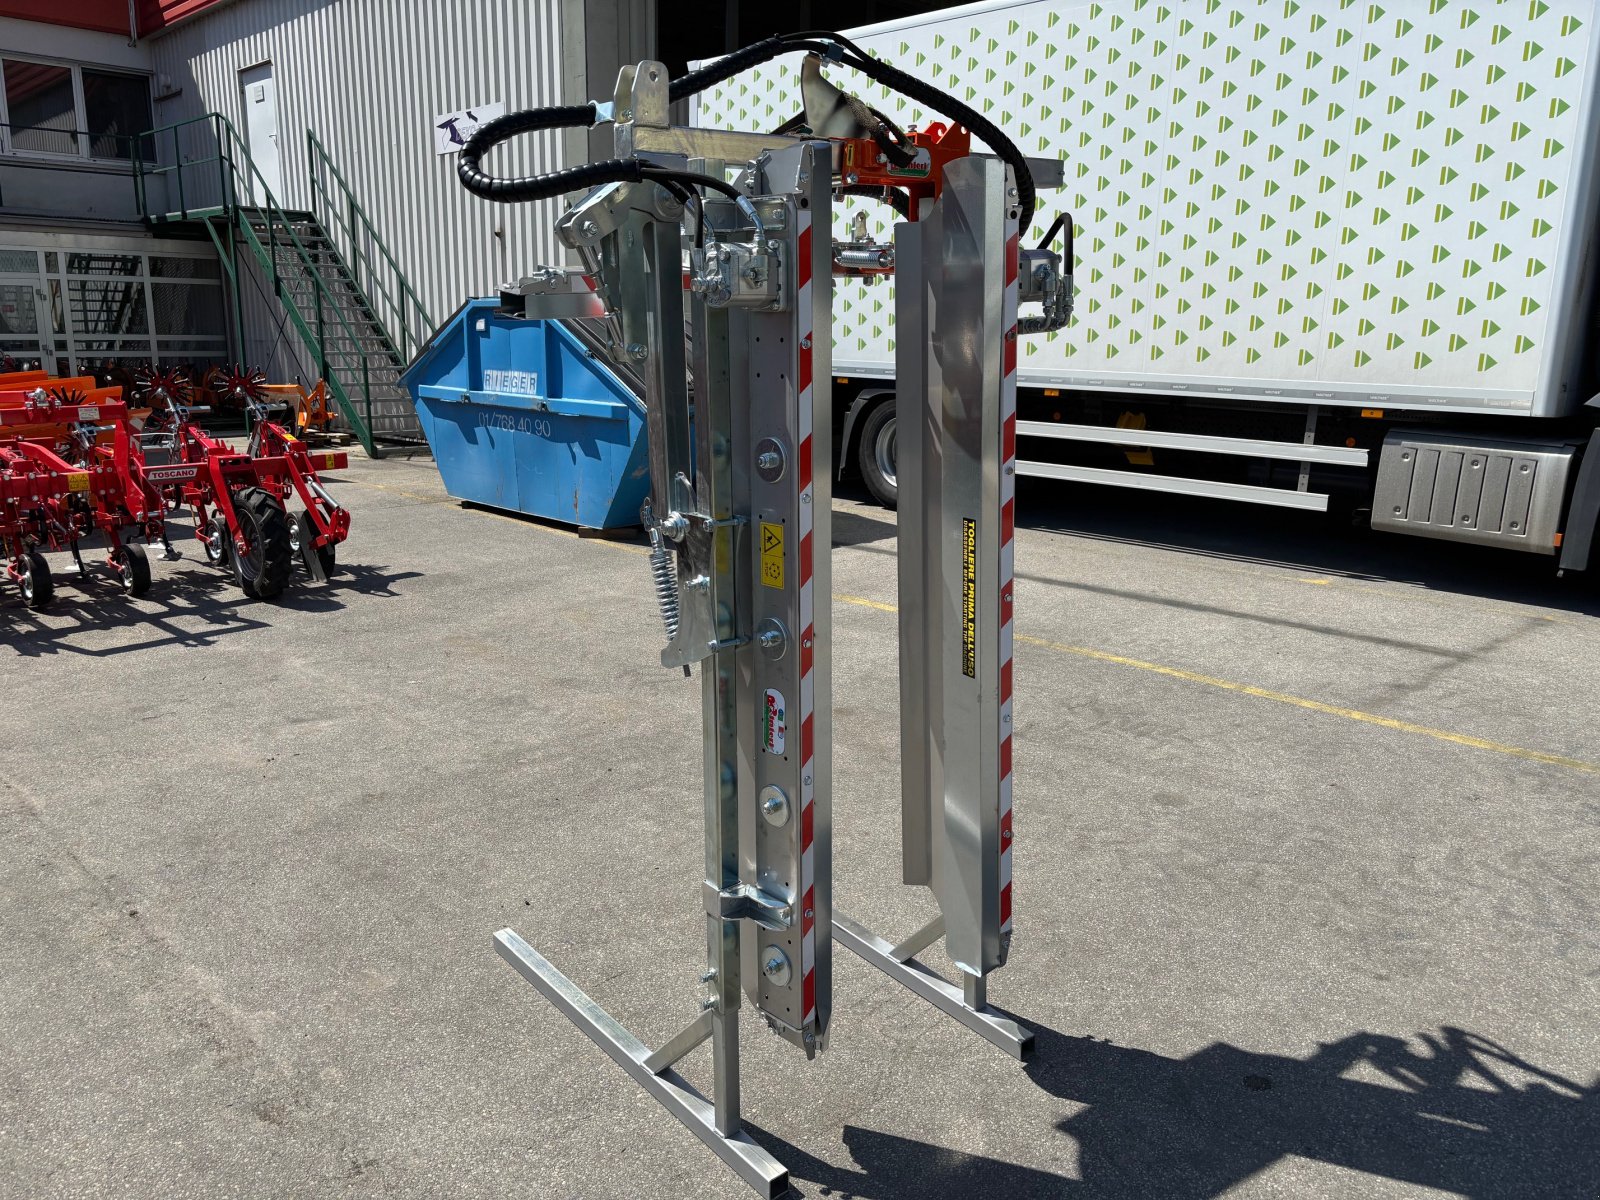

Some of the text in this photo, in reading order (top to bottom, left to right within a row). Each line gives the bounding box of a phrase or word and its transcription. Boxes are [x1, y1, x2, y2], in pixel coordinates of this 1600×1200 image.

[485, 373, 536, 391] RIEGER
[479, 412, 551, 437] 01/768 40 90
[152, 469, 195, 479] TOSCANO
